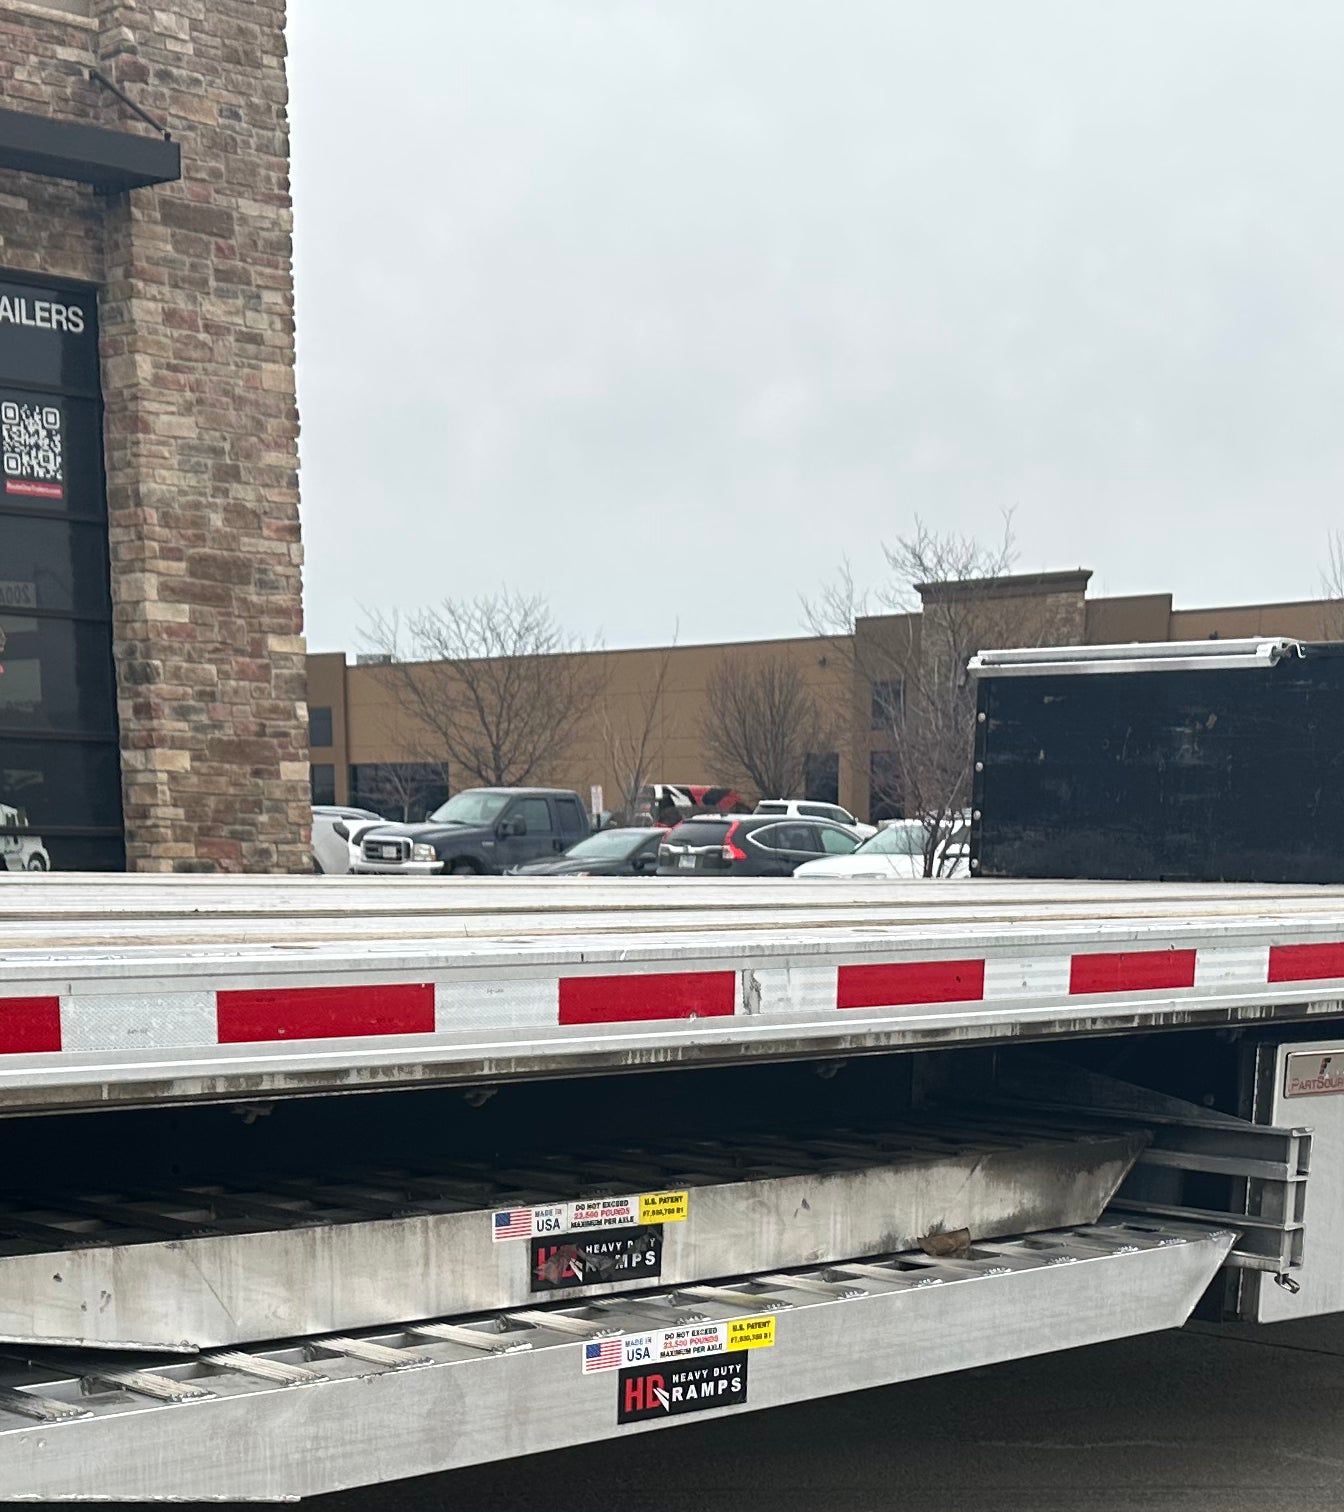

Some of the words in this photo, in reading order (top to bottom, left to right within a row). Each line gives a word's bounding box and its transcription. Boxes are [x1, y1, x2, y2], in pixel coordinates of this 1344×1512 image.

[536, 1218, 561, 1232] USA
[585, 1241, 622, 1254] HEAVY
[626, 1346, 651, 1362] USA
[672, 1368, 709, 1384] HEAVY
[713, 1363, 742, 1377] DUTY
[624, 1373, 666, 1412] HD
[671, 1376, 742, 1402] RAMPS
